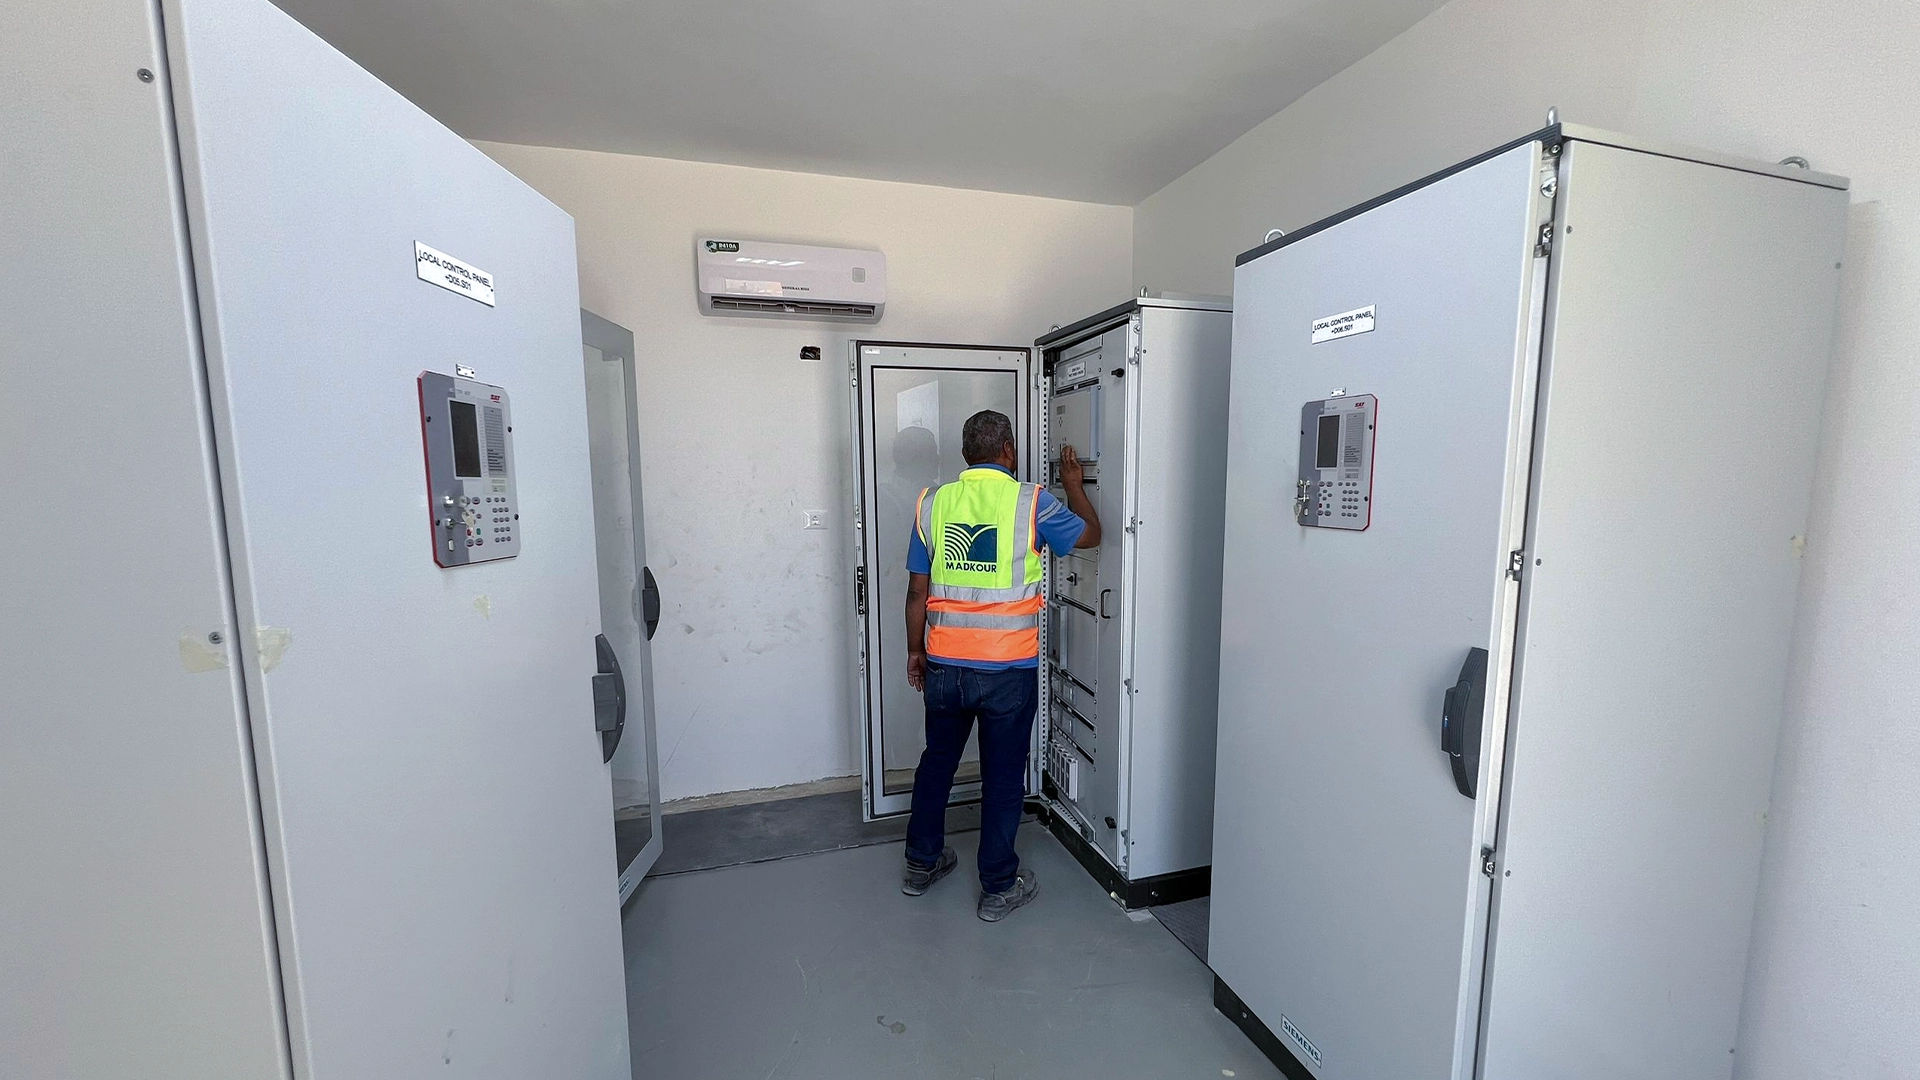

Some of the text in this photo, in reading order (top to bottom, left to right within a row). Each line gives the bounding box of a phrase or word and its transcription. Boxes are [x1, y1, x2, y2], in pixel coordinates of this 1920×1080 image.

[419, 250, 491, 288] LOCAL CONTROL PANEL
[1314, 310, 1372, 331] LOCAL CONTROL PANEL
[946, 562, 997, 573] MADKOUR
[1284, 1021, 1320, 1061] SIEMENS
